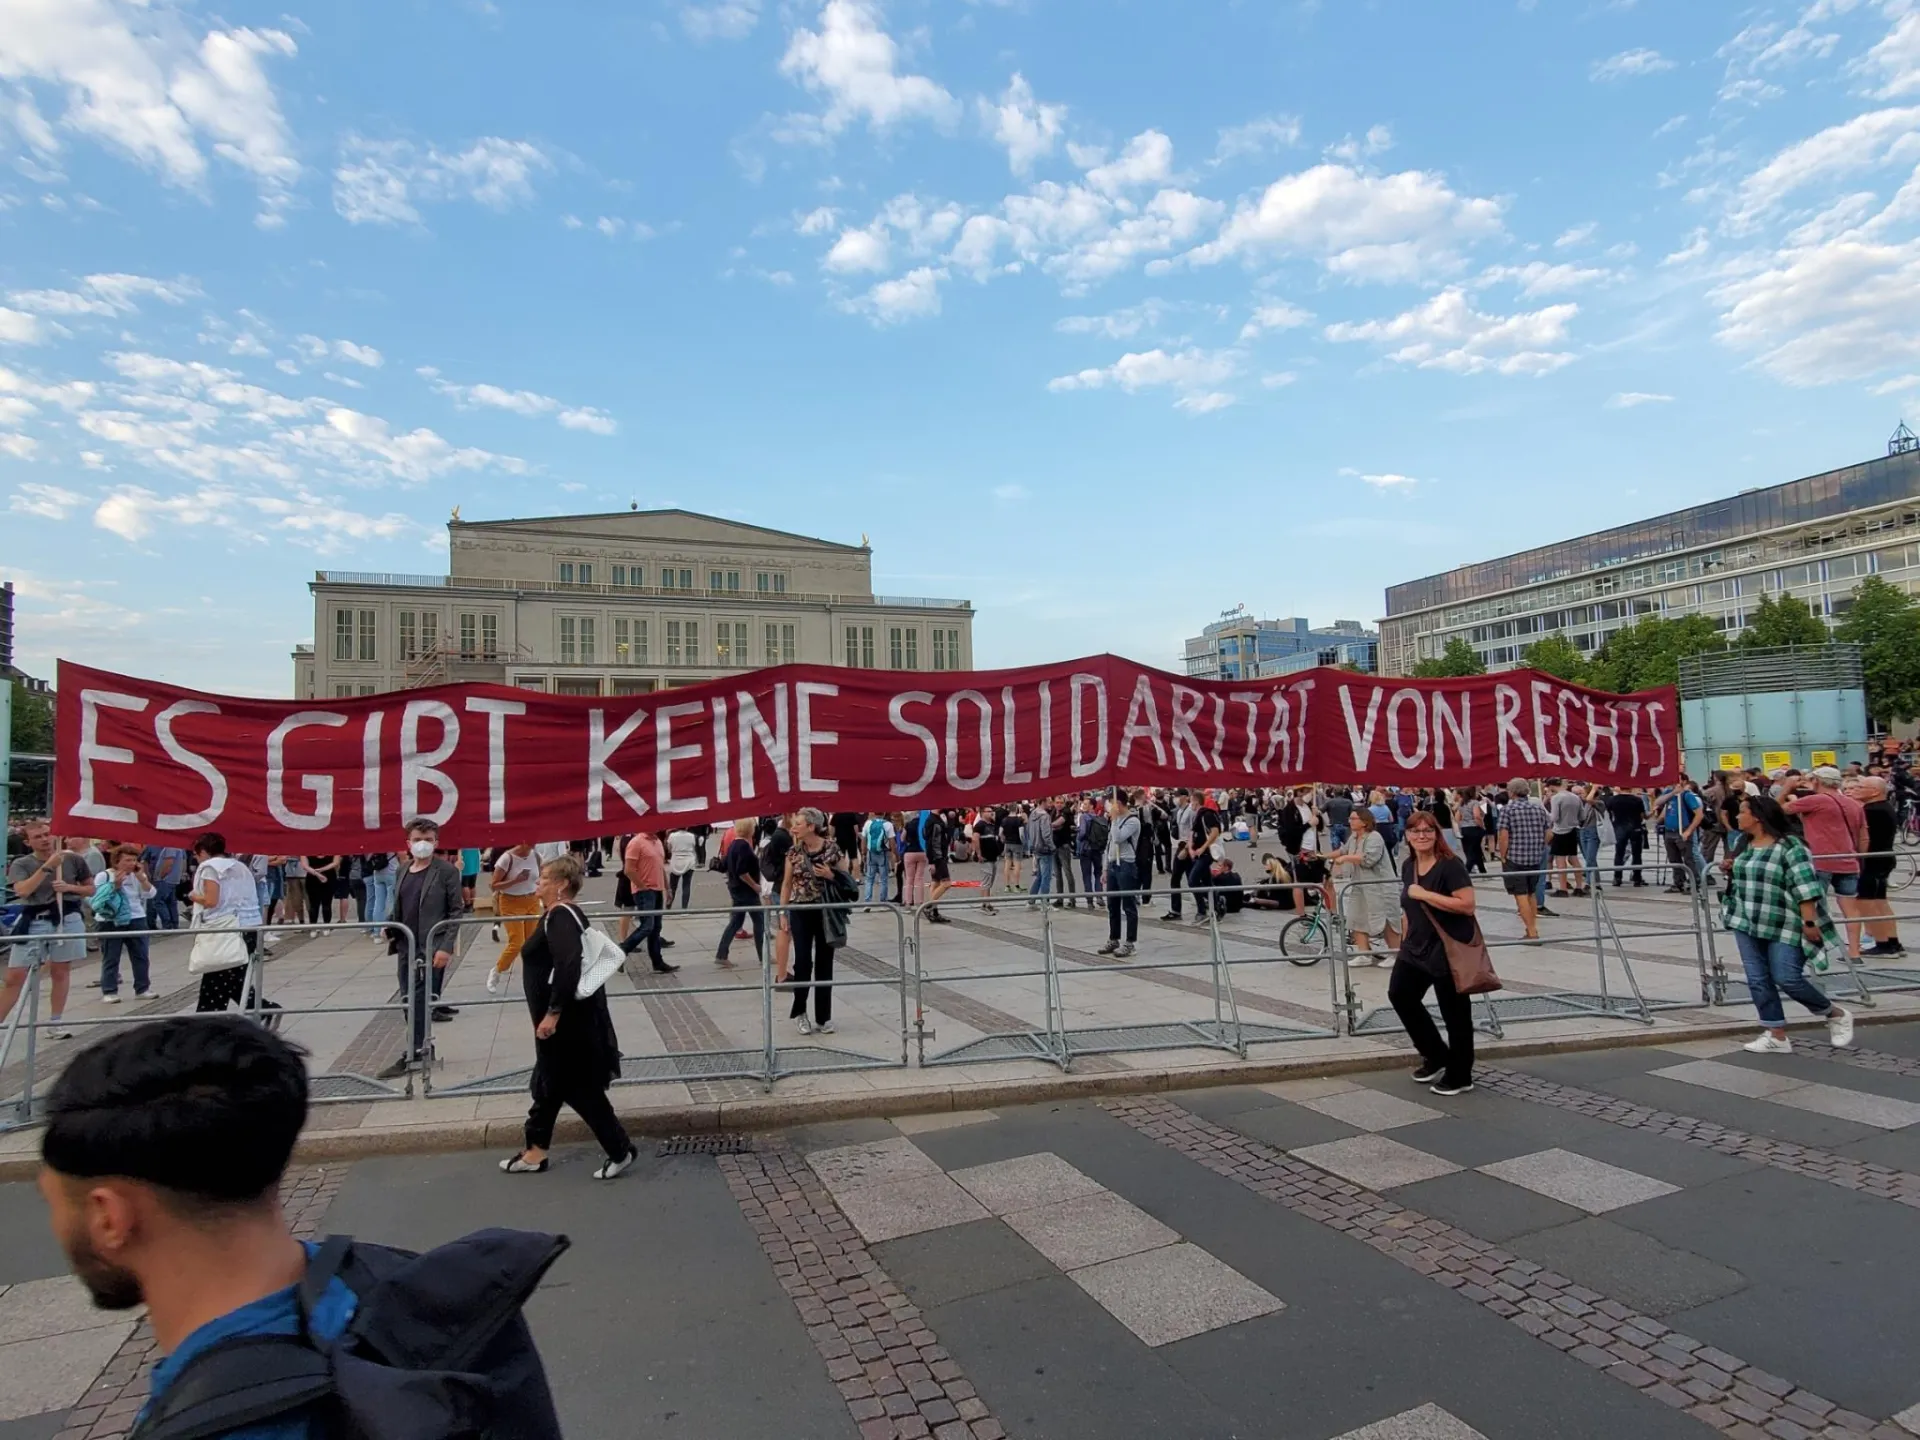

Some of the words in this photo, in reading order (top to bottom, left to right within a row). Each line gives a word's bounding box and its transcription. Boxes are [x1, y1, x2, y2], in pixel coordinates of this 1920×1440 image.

[69, 689, 229, 831] ES
[266, 696, 526, 831] GIBT
[588, 682, 840, 821] KEINE
[889, 674, 1316, 797] SOLIDARITÄT
[1338, 684, 1472, 773] VON
[1495, 681, 1664, 777] RECHTS
